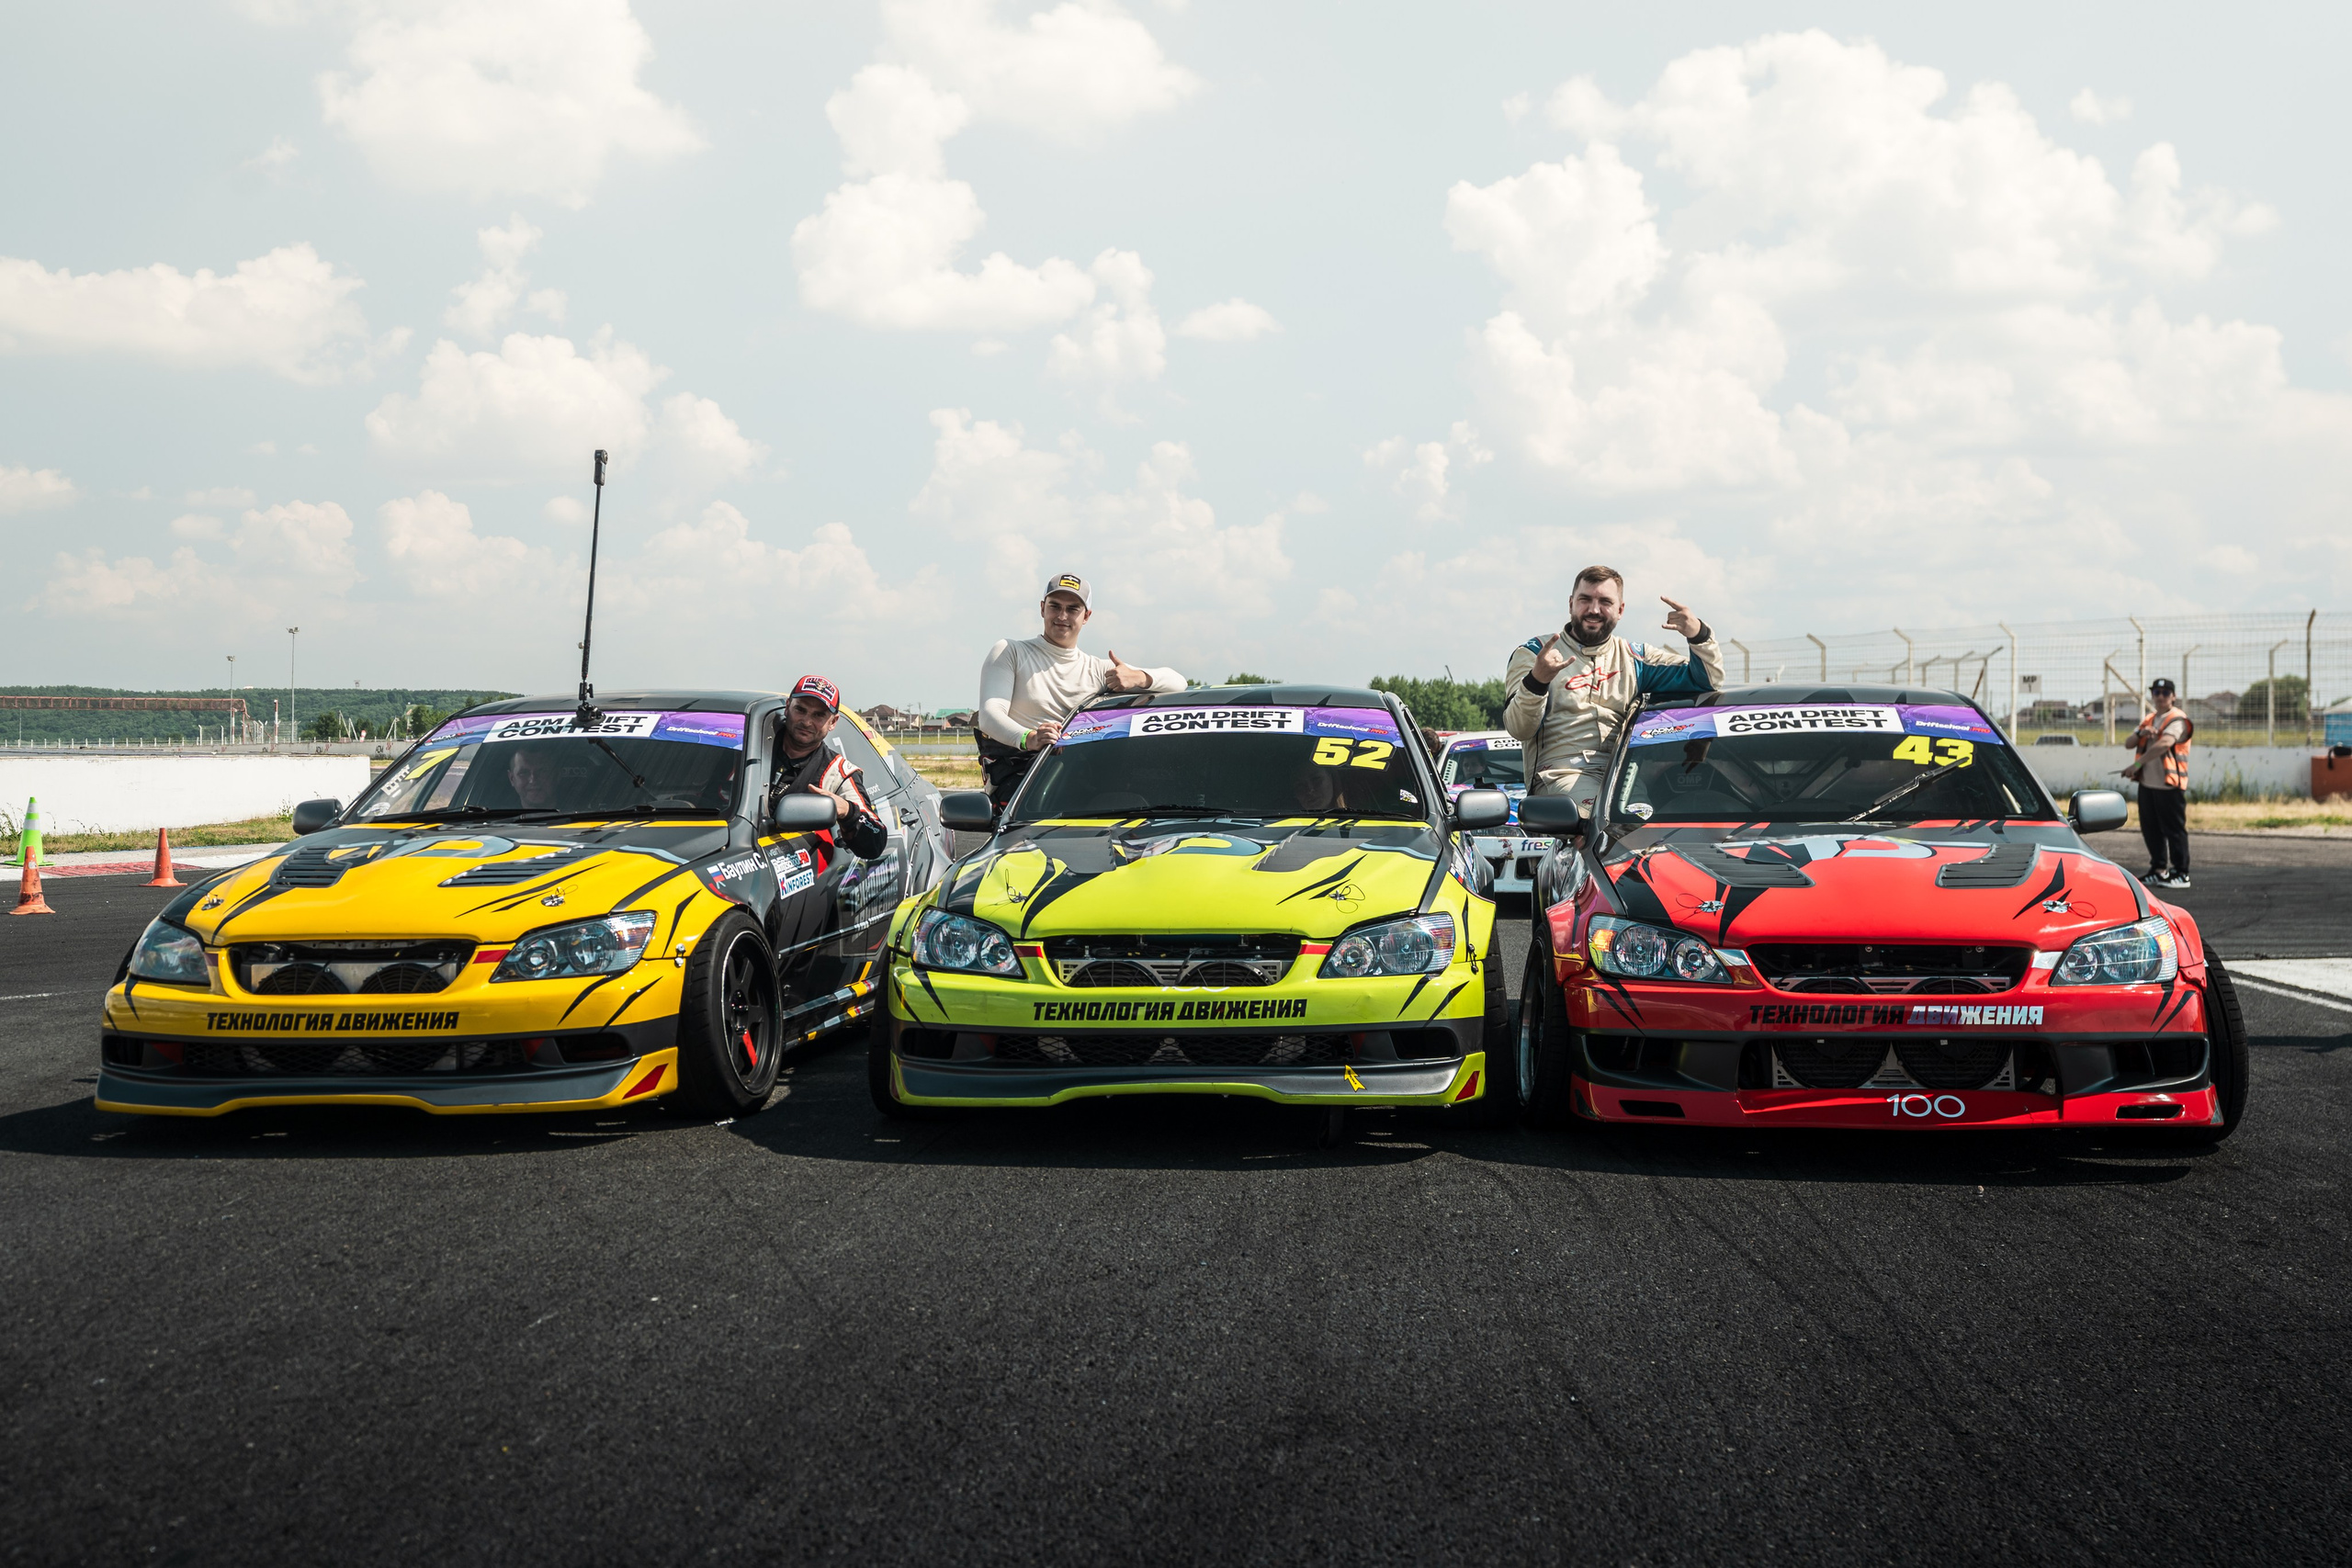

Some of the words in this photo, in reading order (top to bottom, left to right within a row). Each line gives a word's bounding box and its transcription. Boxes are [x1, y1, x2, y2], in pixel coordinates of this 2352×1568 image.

[503, 717, 565, 730] ADM
[1141, 719, 1292, 733] CONTEST
[1144, 711, 1205, 724] ADM
[1212, 710, 1292, 719] DRIFT
[1728, 710, 1794, 724] ADM
[1800, 709, 1884, 718] DRIFT
[1728, 718, 1888, 733] CONTEST
[497, 724, 643, 739] CONTEST
[1313, 738, 1394, 770] 52
[1893, 736, 1974, 768] 43
[403, 747, 459, 781] 7
[1521, 840, 1555, 852] fres
[717, 857, 755, 881] Баулин
[779, 872, 813, 896] KINFOREST
[1034, 1002, 1175, 1021] ТЕХНОЛОГИЯ
[1177, 998, 1307, 1021] ДВИЖЕНИЯ
[1749, 1005, 1905, 1025] ТЕХНОЛОГИЯ
[1907, 1006, 2044, 1025] ДВИЖЕНИЯ
[207, 1012, 334, 1031] ТЕХНОЛОГИЯ
[334, 1011, 459, 1031] ДВИЖЕНИЯ
[1886, 1093, 1966, 1118] 100
